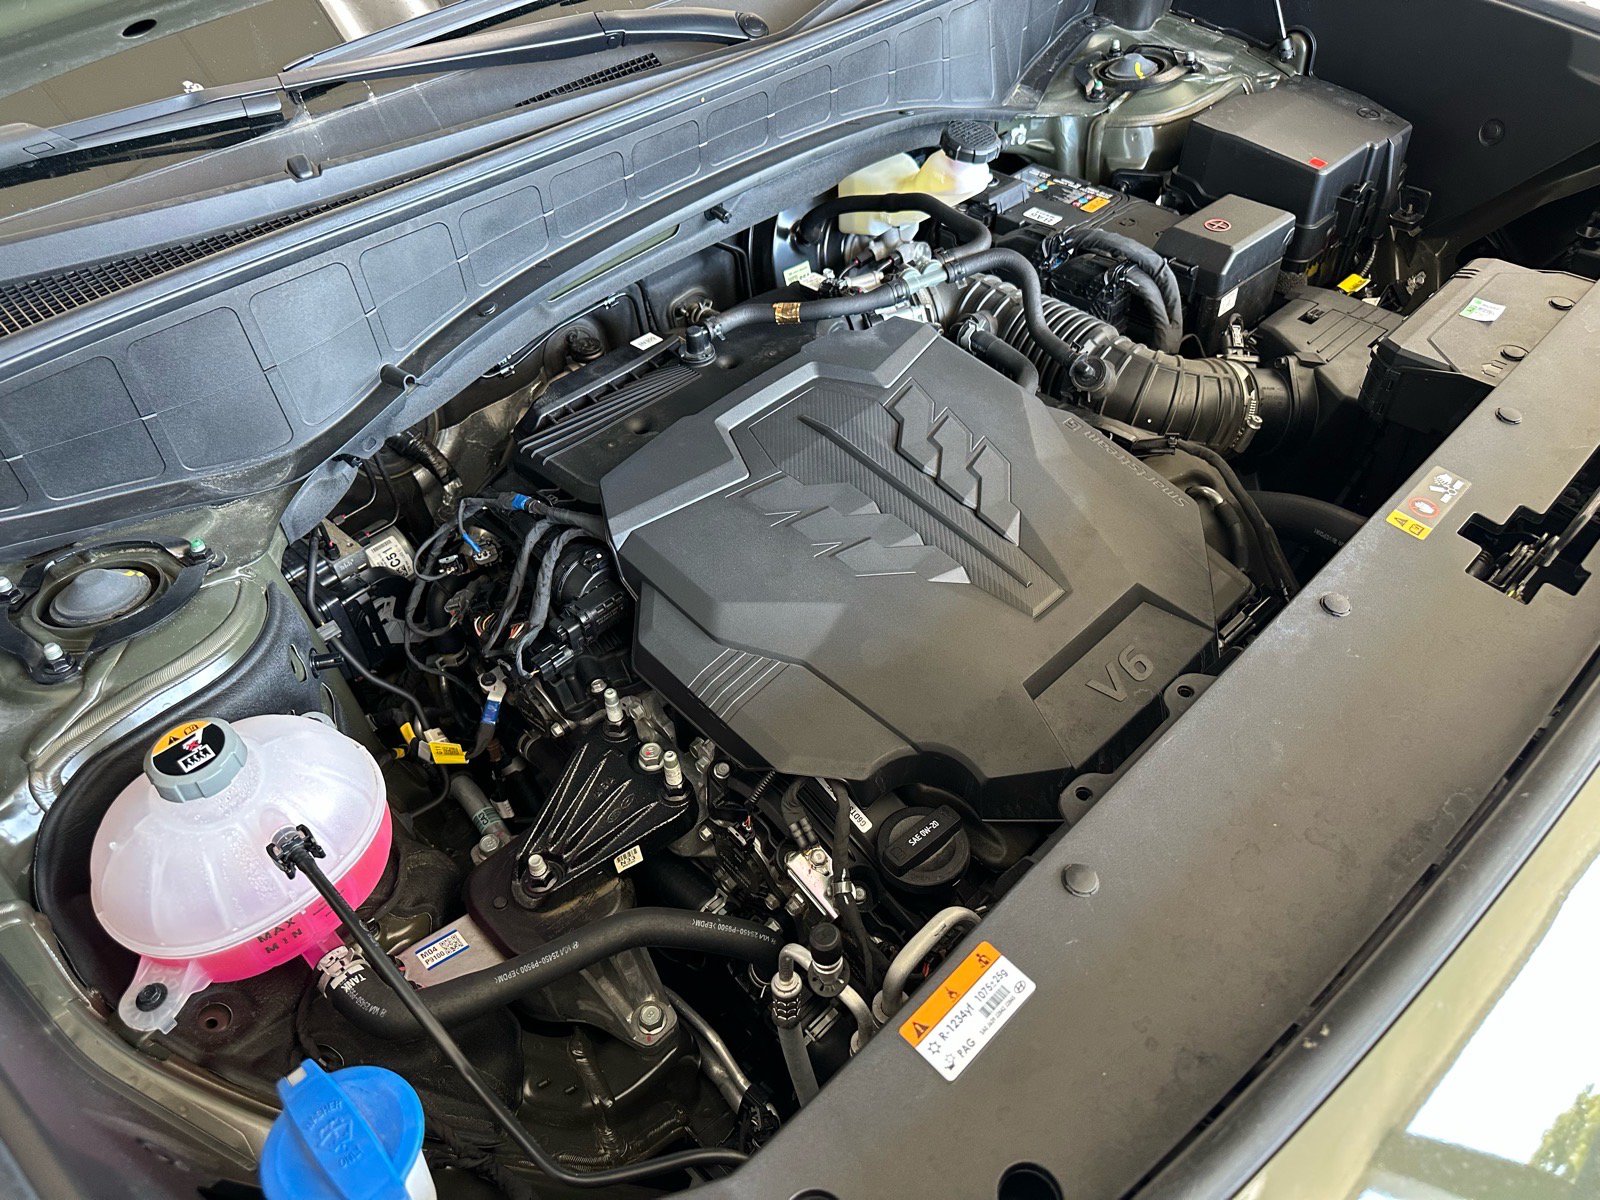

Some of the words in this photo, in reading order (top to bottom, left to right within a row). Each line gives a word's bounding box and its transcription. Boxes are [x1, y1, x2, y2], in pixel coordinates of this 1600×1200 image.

[1083, 430, 1190, 508] Smartstream
[1085, 645, 1154, 702] V6
[908, 833, 923, 847] SAE
[920, 819, 940, 837] 0W-20
[257, 918, 295, 943] MAX
[265, 928, 302, 953] MIN
[420, 946, 438, 959] M04
[341, 973, 367, 993] TANK
[938, 1002, 975, 1042] R-1234yf
[957, 1038, 976, 1058] PAG
